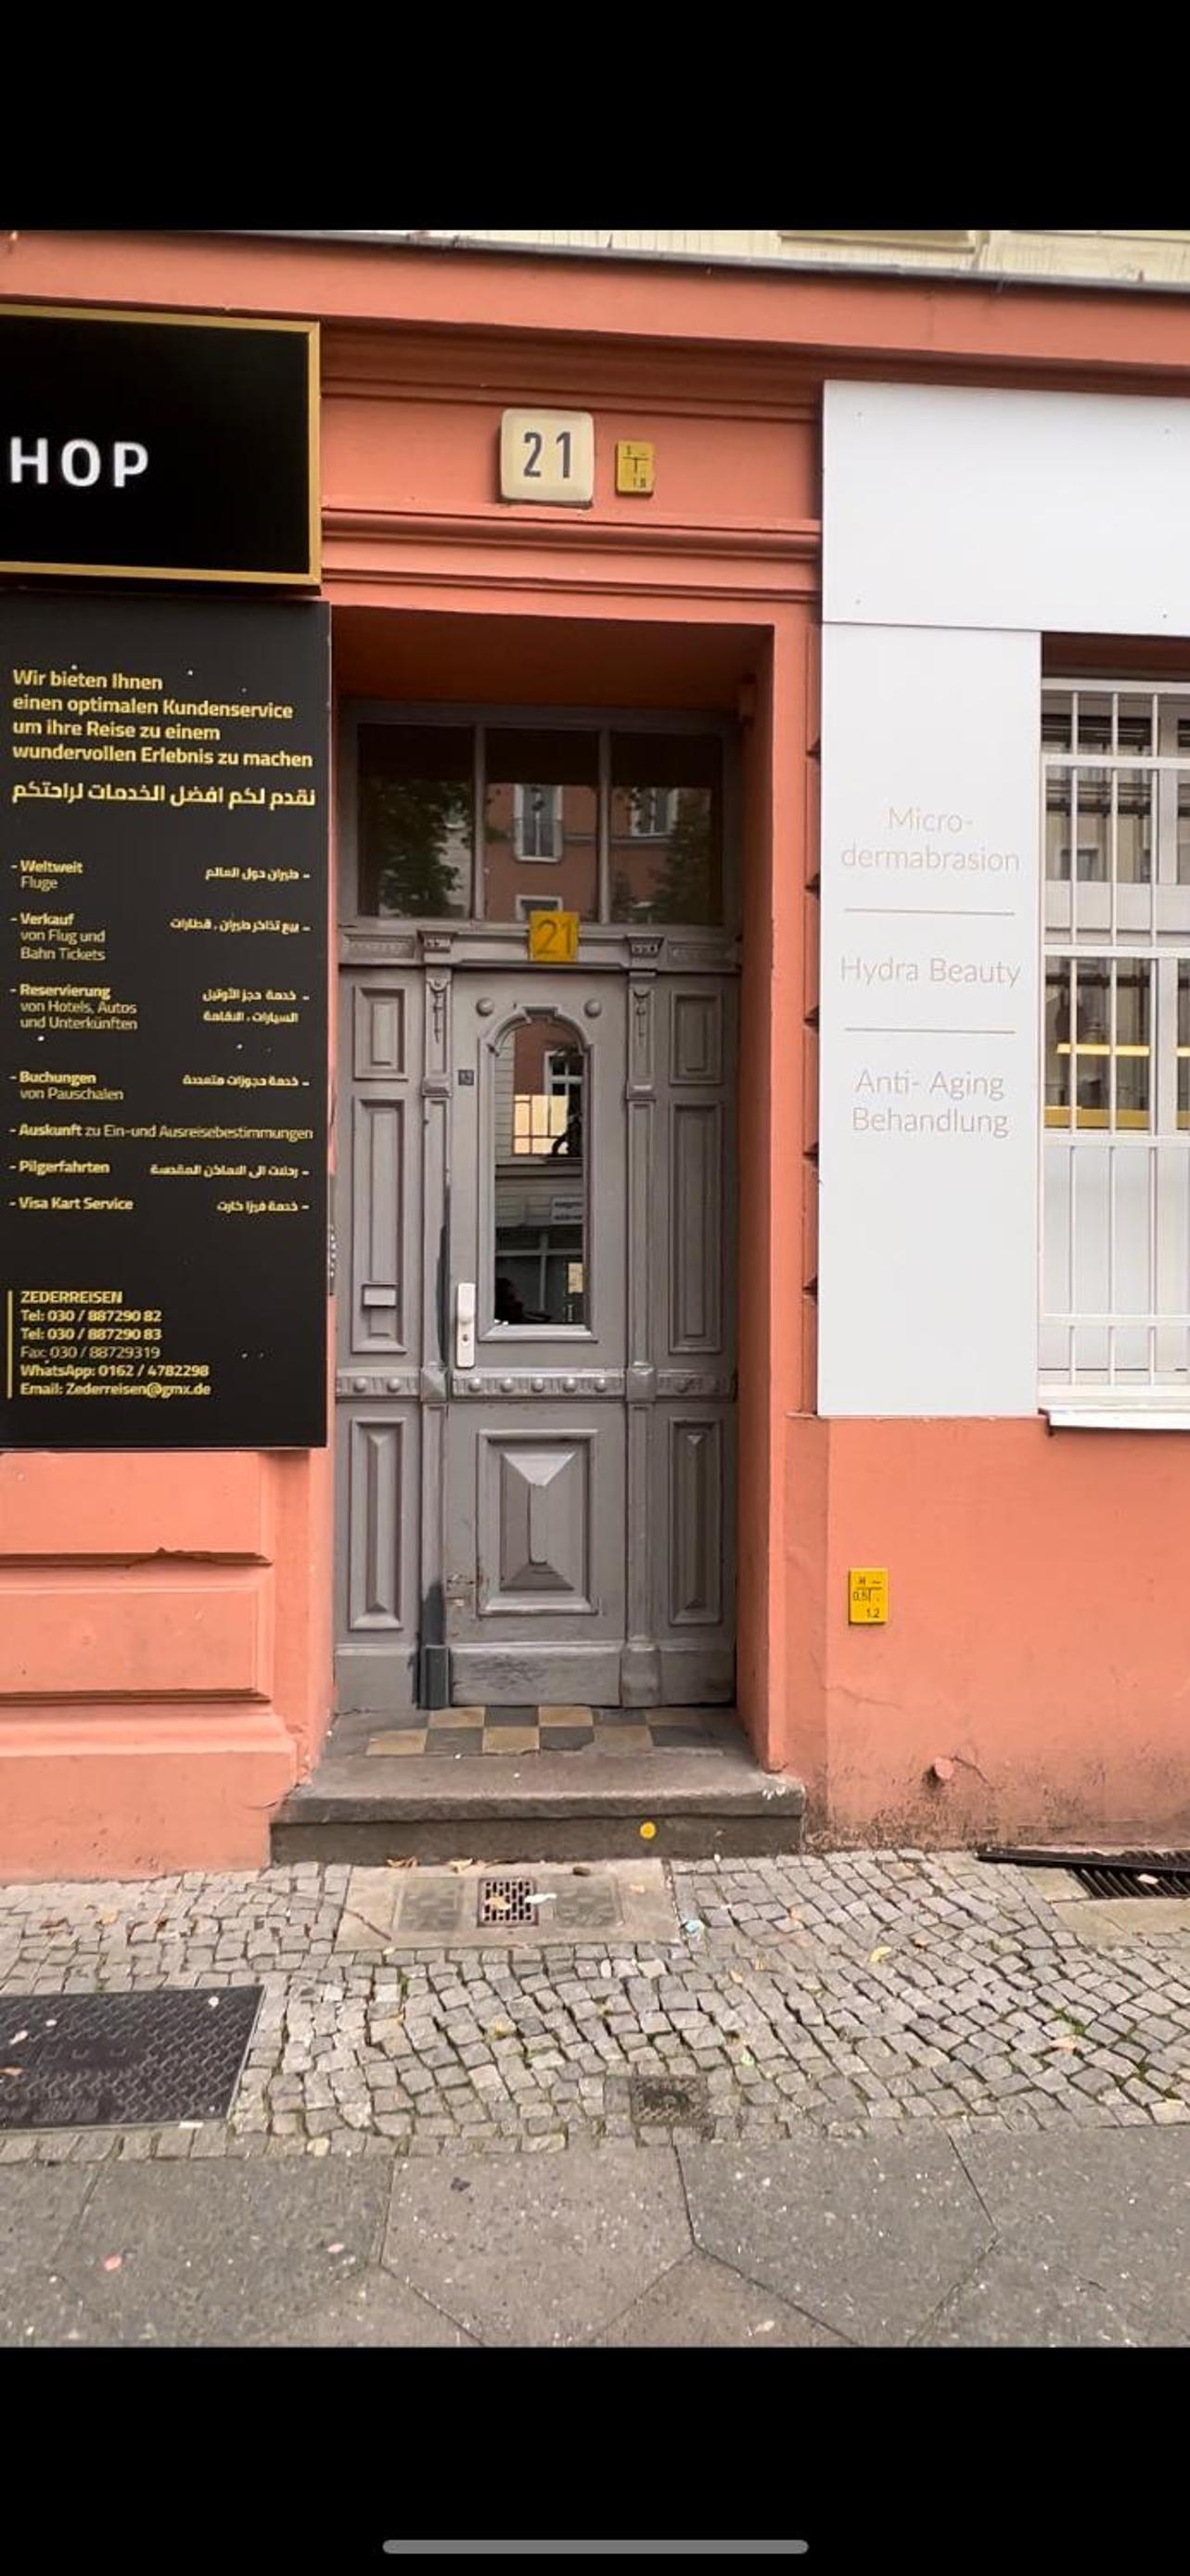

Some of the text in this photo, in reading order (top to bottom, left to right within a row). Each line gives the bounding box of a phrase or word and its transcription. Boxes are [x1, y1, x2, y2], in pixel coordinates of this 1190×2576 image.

[523, 431, 571, 478] 21
[13, 670, 162, 690] Wir bieten Ihnen
[13, 695, 293, 719] einen optimalen Kundenservice
[13, 719, 220, 740] um ihre Reise zu einem
[13, 744, 313, 767] wundervollen Erlebnis zu machen
[12, 781, 315, 810] نقدم لكم افضل الخدمات لراحتكم
[888, 806, 973, 833] Micro-
[841, 843, 1020, 872] dermabrasion
[20, 860, 83, 874] Weltweit
[205, 867, 240, 880] العالم
[241, 867, 266, 881] حول
[267, 868, 300, 882] طيران
[20, 912, 74, 925] Verkauf
[220, 920, 250, 932] طيران
[20, 929, 105, 945] von Flug und
[537, 919, 571, 954] 21
[21, 947, 106, 961] Bahn Tickets
[841, 956, 1021, 989] Hydra Beauty
[20, 984, 110, 1001] Reservierung
[242, 989, 262, 1002] حجز
[265, 989, 296, 1001] خدمة
[20, 1002, 45, 1012] von
[97, 1001, 136, 1014] Autos
[20, 1016, 45, 1028] und
[19, 1071, 96, 1087] Buchungen
[268, 1076, 299, 1086] خدمة
[854, 1069, 1004, 1102] Anti- Aging
[20, 1087, 123, 1100] von Pauschalen
[851, 1105, 1009, 1140] Behandlung
[19, 1124, 83, 1136] Auskunft
[85, 1127, 100, 1136] zu
[160, 1126, 313, 1142] Ausreisebestimmungen
[19, 1160, 109, 1176] Pilgerfahrten
[150, 1165, 201, 1175] المقدسة
[19, 1197, 48, 1209] Visa
[51, 1197, 81, 1209] Kart
[83, 1197, 133, 1209] Service
[268, 1201, 298, 1211] خدمة
[21, 1291, 122, 1304] ZEDERREISEN
[20, 1309, 45, 1321] Tel:
[47, 1310, 75, 1321] 030
[87, 1310, 141, 1321] 887290
[143, 1310, 161, 1322] 82
[21, 1328, 45, 1340] Tel:
[47, 1328, 75, 1340] 030
[88, 1329, 141, 1340] 887290
[144, 1329, 162, 1340] 83
[50, 1346, 77, 1358] 030
[89, 1346, 160, 1358] 88729319
[20, 1364, 209, 1379] WhatsApp: 0162 / 4782298
[20, 1383, 211, 1398] Email: Zederreisen@gmx.de
